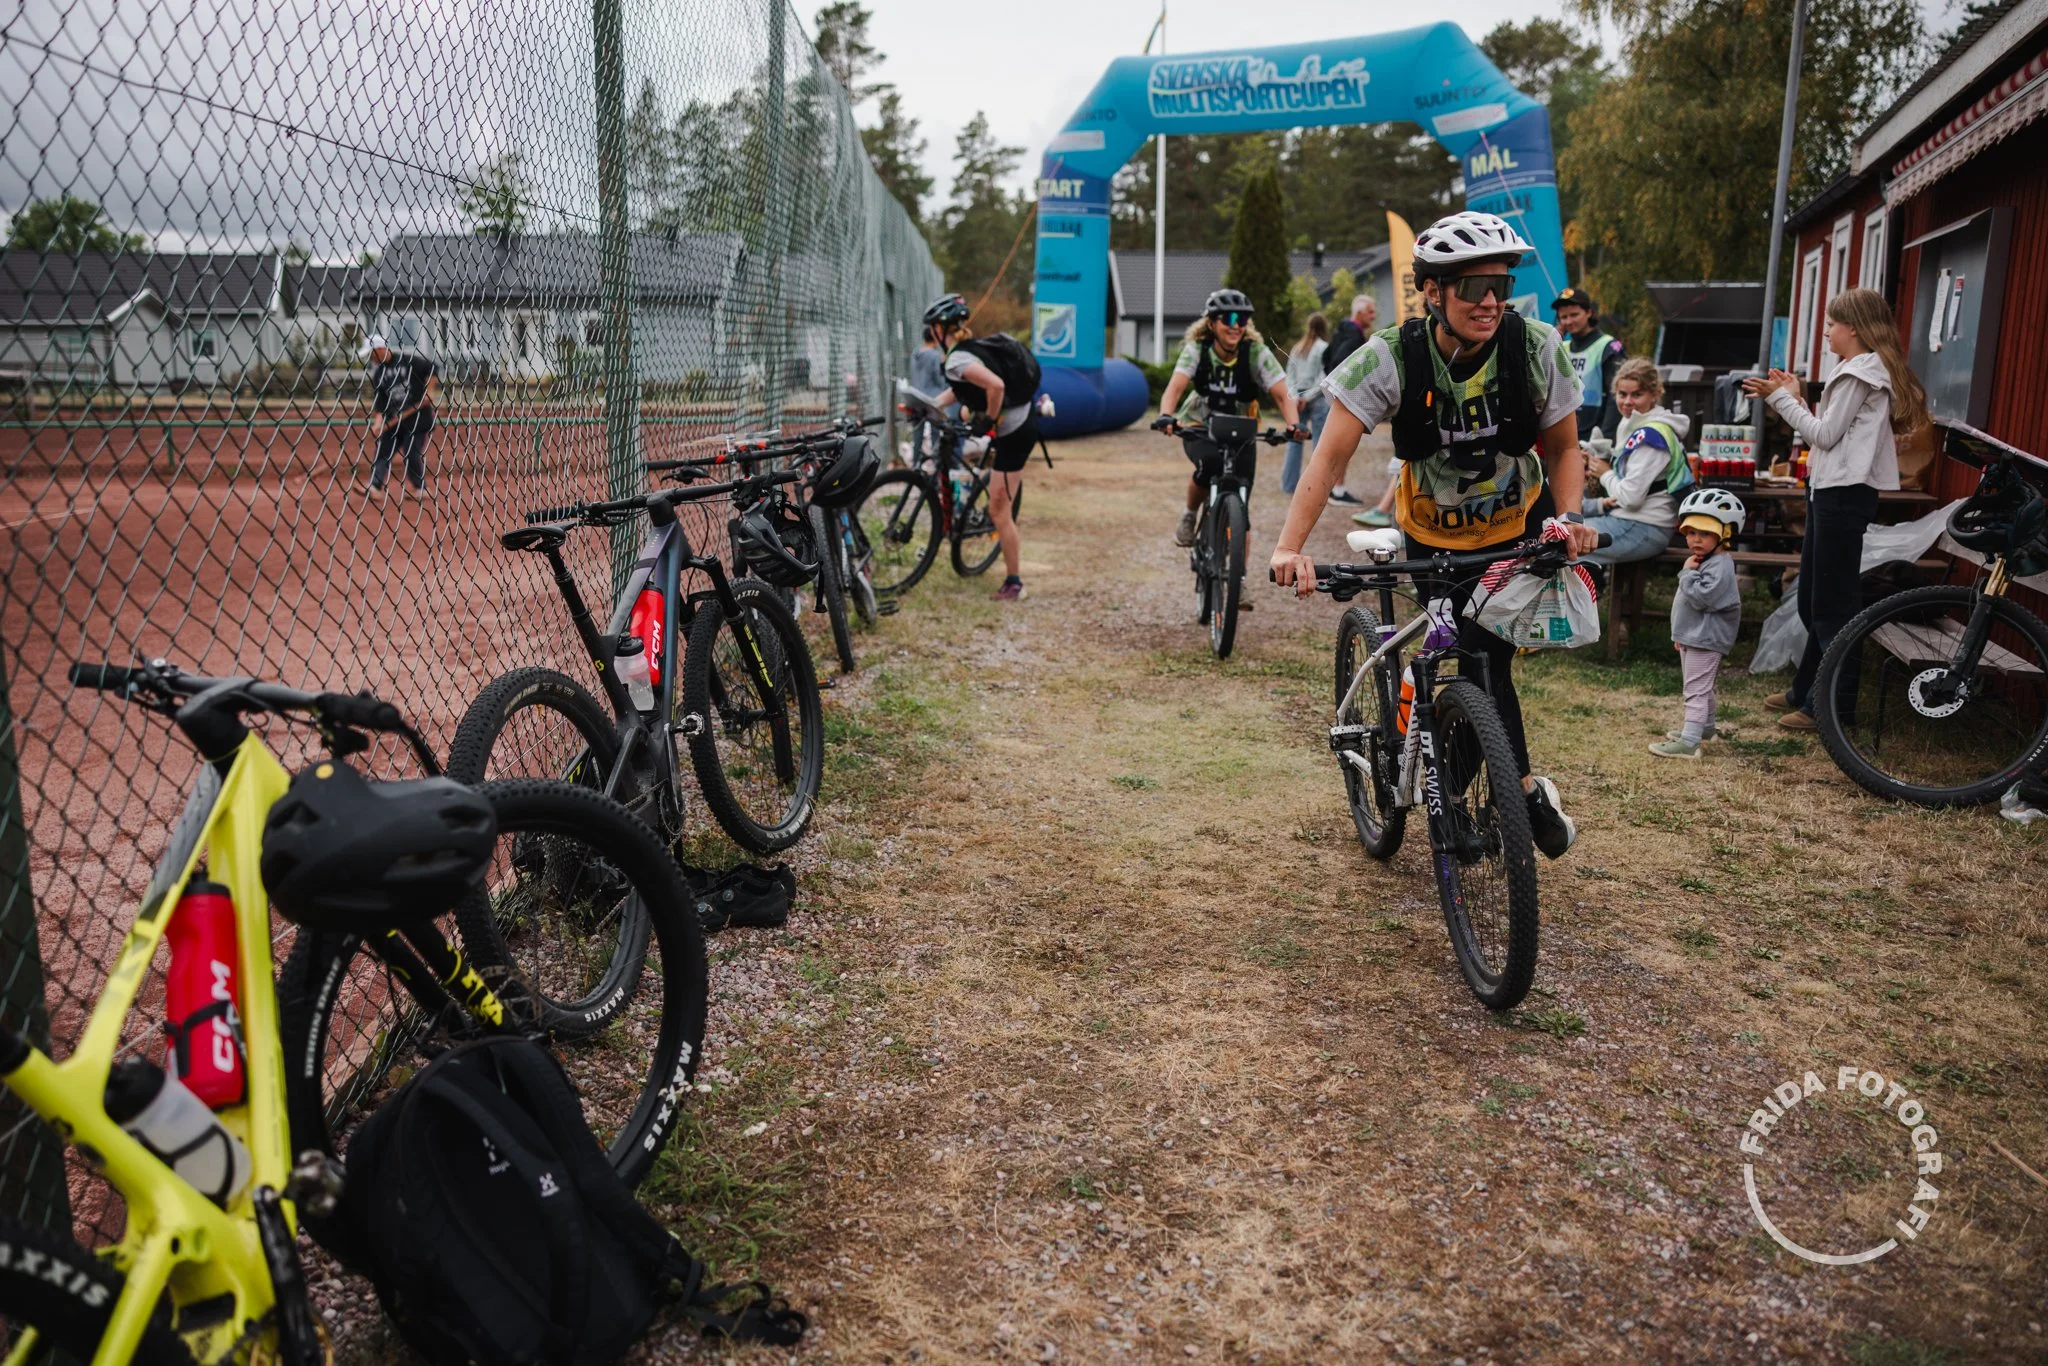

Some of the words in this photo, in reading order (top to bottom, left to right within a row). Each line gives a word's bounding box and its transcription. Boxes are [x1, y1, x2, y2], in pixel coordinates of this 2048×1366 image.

[1154, 60, 1250, 88] SVENSKA
[1152, 78, 1362, 115] MULTISPORTCUPEN
[1414, 86, 1487, 110] SUUNTO
[1470, 145, 1519, 178] MÅL
[1719, 446, 1742, 455] LOKA
[651, 620, 661, 671] CCM
[1419, 730, 1435, 759] DT
[1424, 765, 1443, 816] SWISS
[584, 986, 625, 1023] MAXXIS
[643, 1040, 693, 1152] MAXXIS
